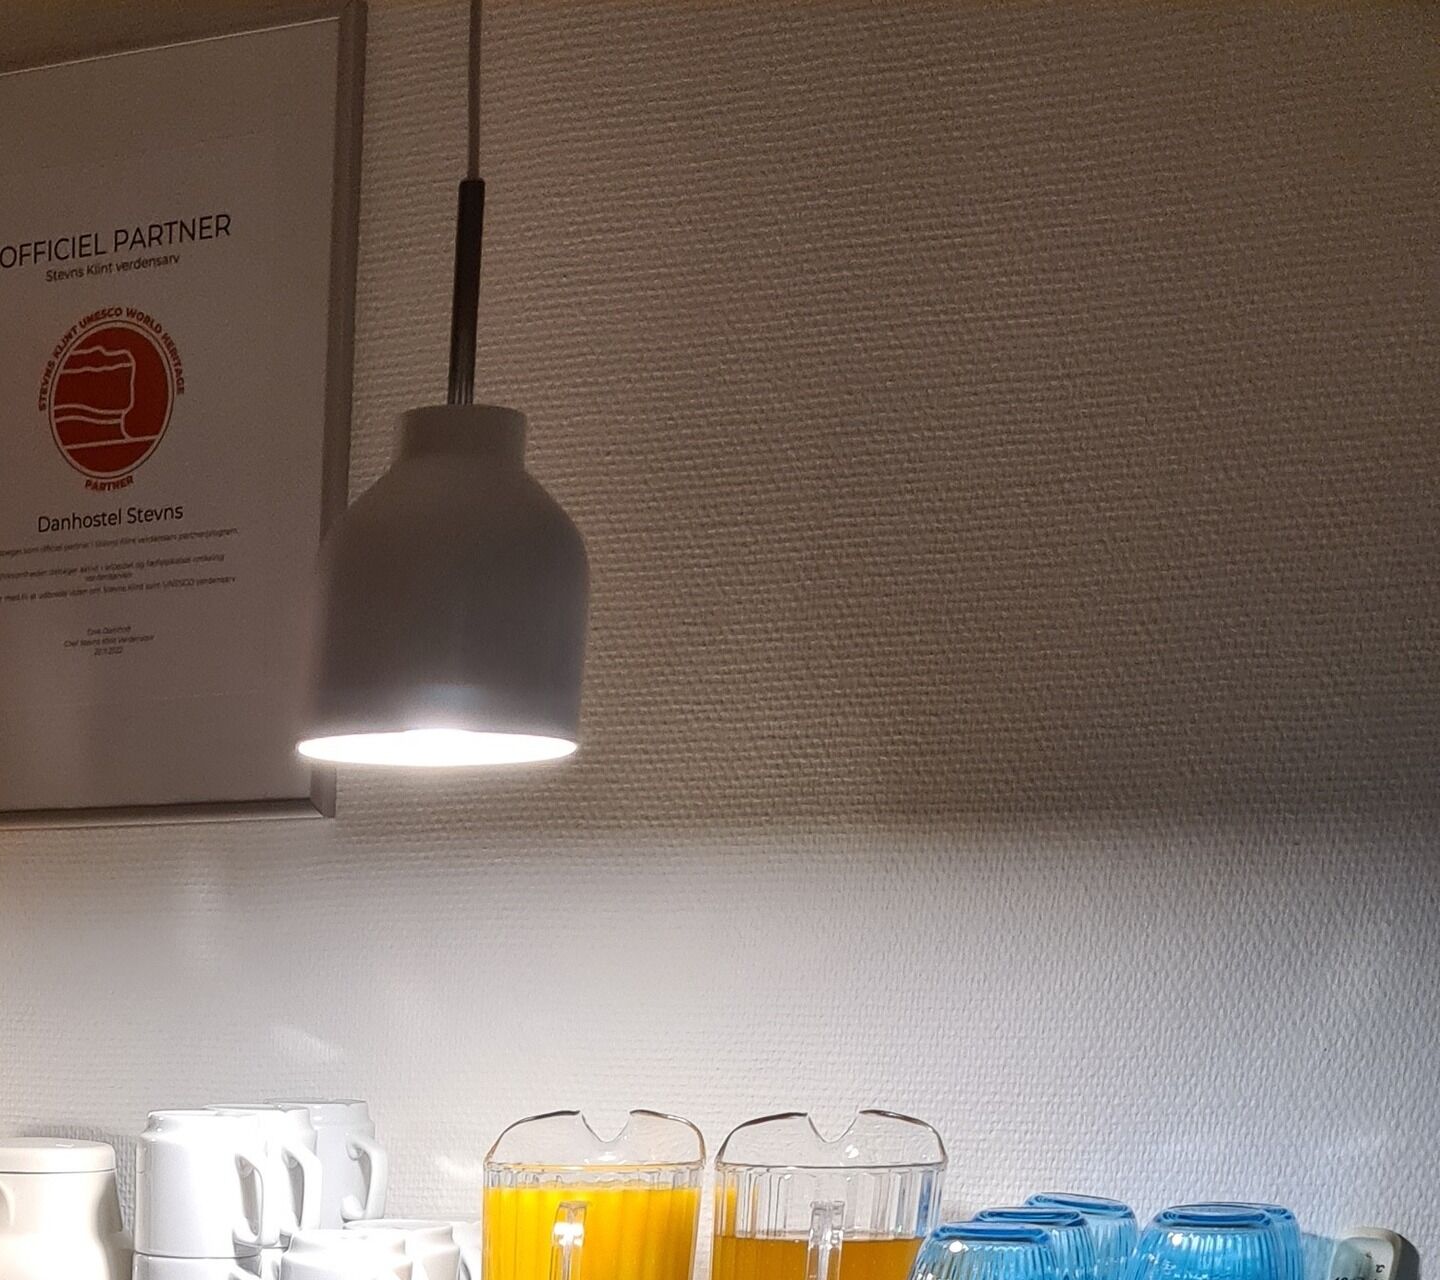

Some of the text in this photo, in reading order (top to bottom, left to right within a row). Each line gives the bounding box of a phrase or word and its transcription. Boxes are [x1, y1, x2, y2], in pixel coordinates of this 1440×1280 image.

[0, 213, 232, 269] OFFICIEL PARTNER
[45, 253, 181, 282] Stevns Klint verdensarv
[79, 307, 123, 329] UNESCO
[126, 307, 163, 334] WORLD
[161, 332, 185, 395] HERITAGE
[84, 475, 135, 491] PARTNER
[38, 506, 184, 533] Danhostel Stevns
